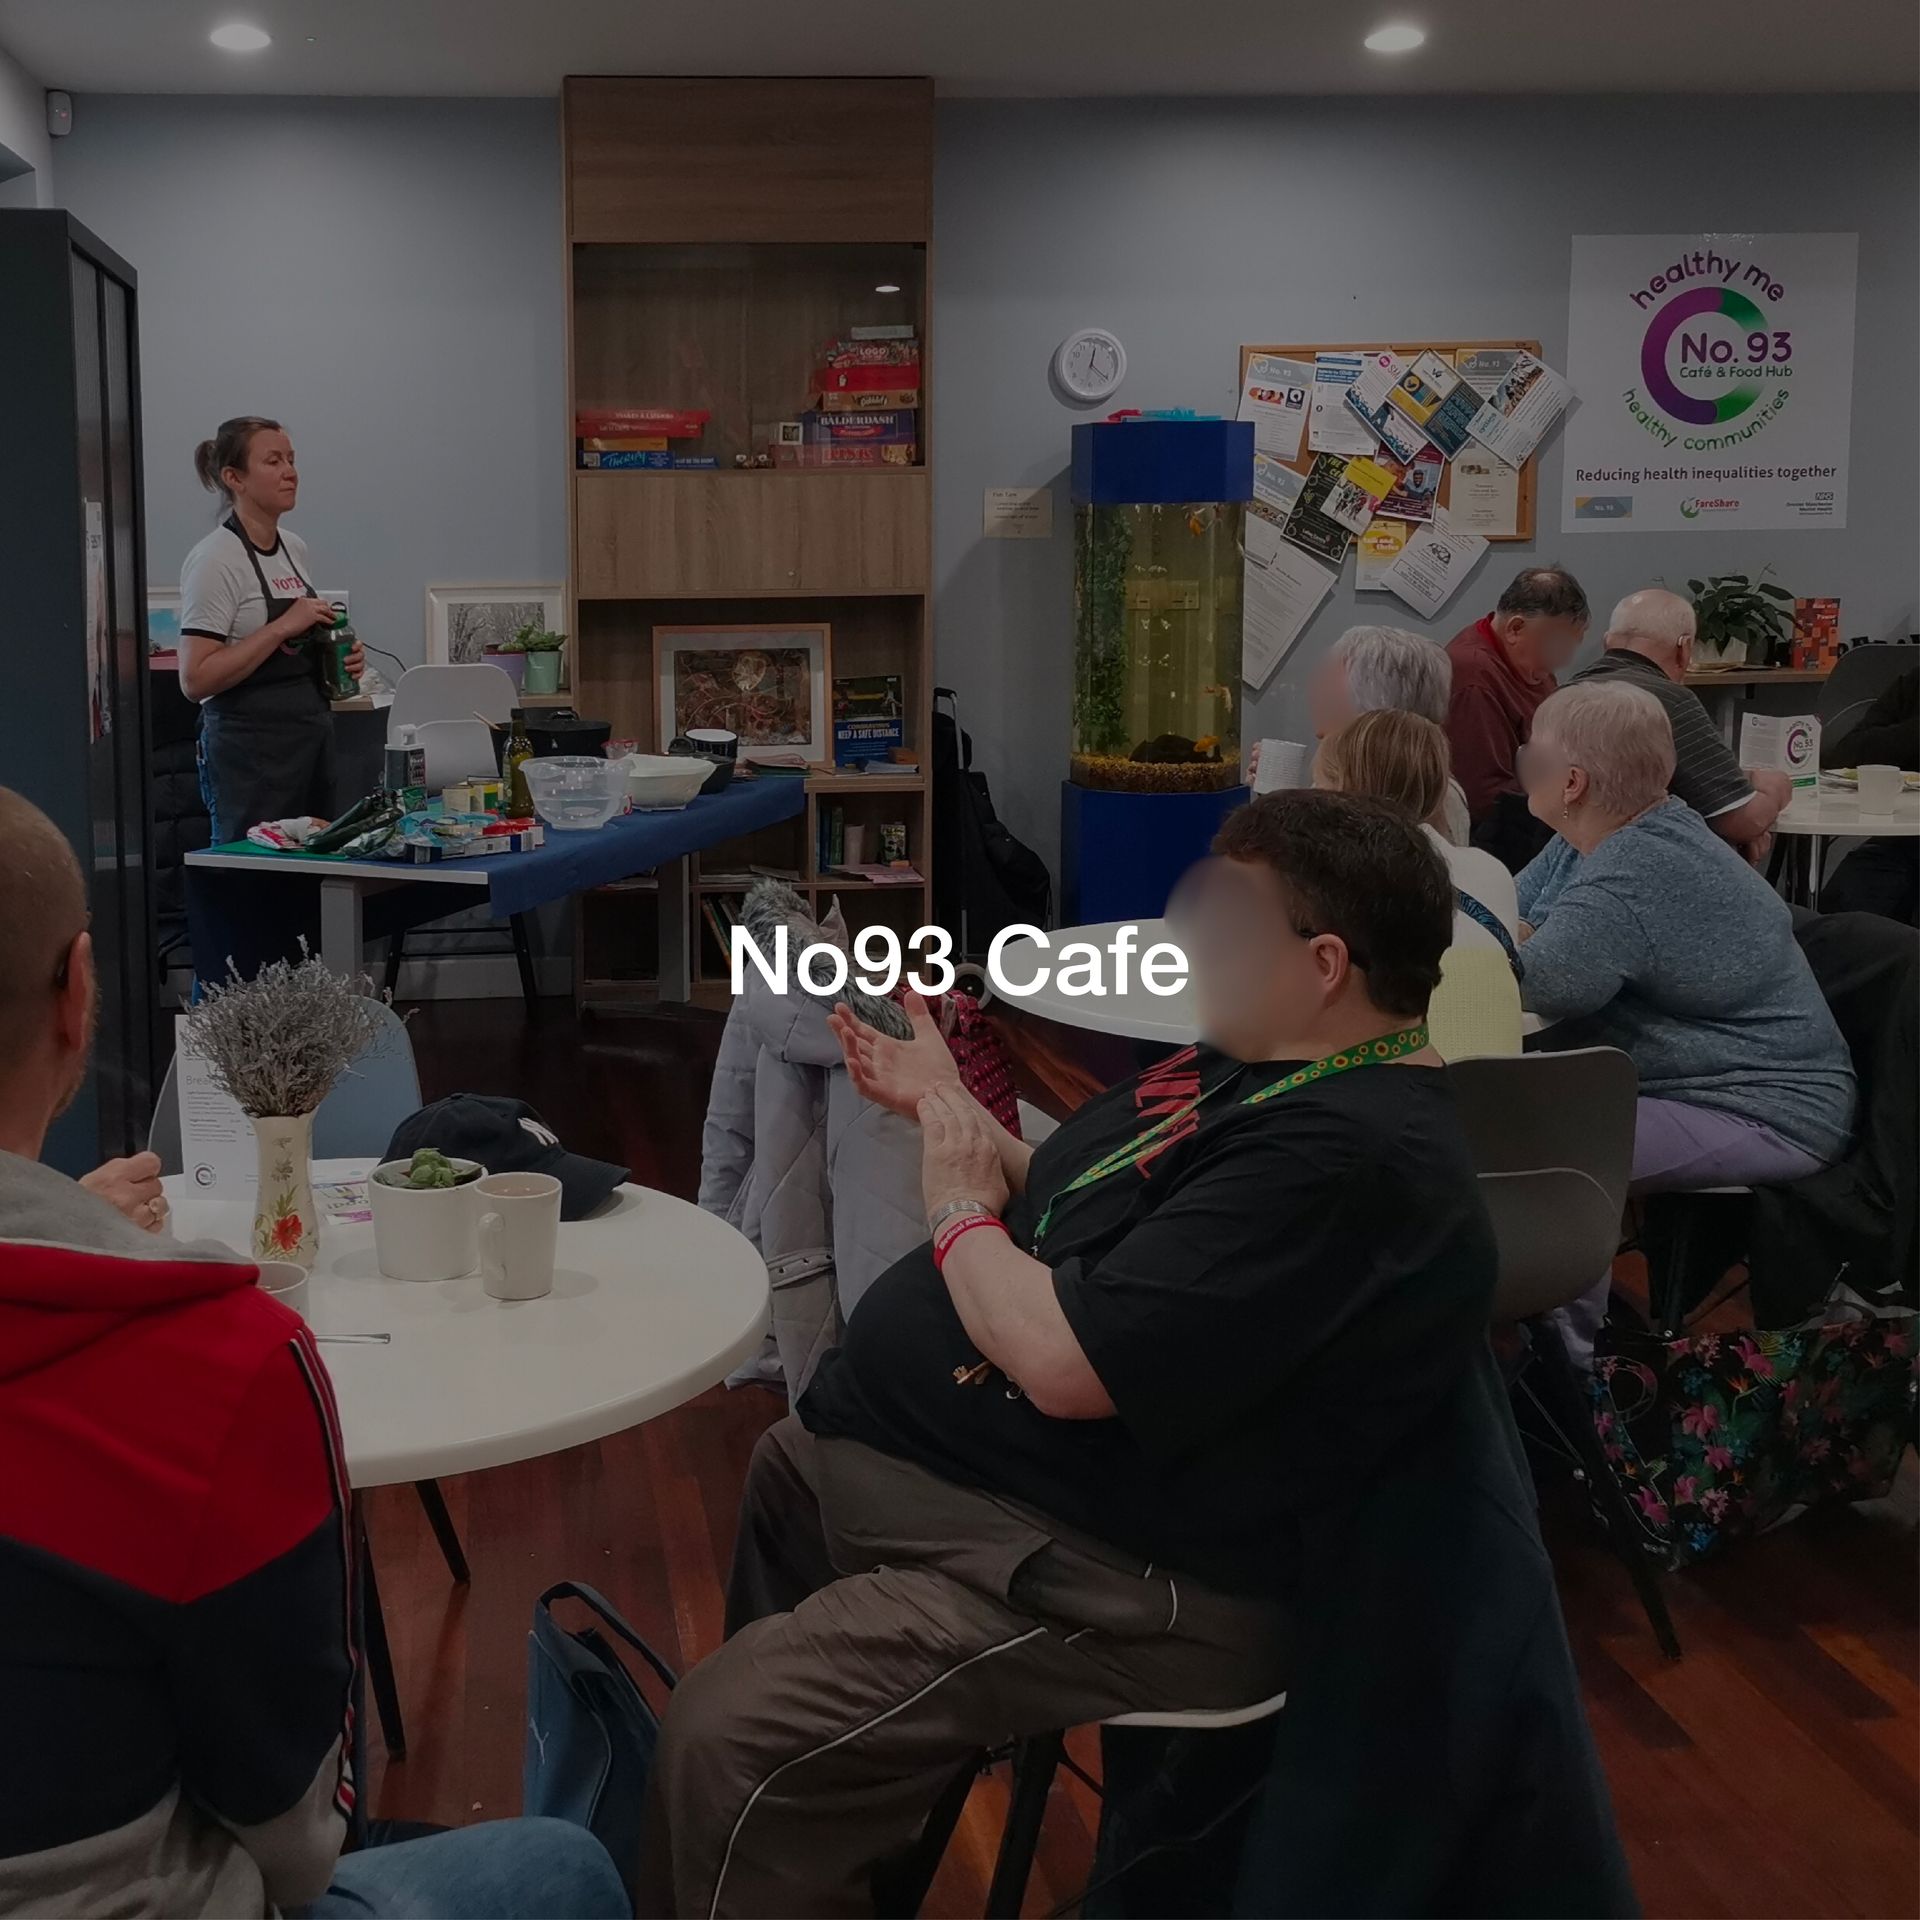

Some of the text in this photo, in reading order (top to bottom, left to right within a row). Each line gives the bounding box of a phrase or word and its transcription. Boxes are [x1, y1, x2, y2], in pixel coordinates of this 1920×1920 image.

[1629, 250, 1784, 310] healthy me
[1681, 332, 1793, 364] No. 93
[1679, 365, 1793, 378] Café & Food Hub
[820, 414, 895, 426] BALDERDASH
[1622, 388, 1678, 448] healthy
[1684, 388, 1790, 451] communities
[1576, 465, 1837, 484] Reducing health inequalities together
[1695, 499, 1740, 509] FareShare
[938, 1216, 986, 1250] Medical Alert
